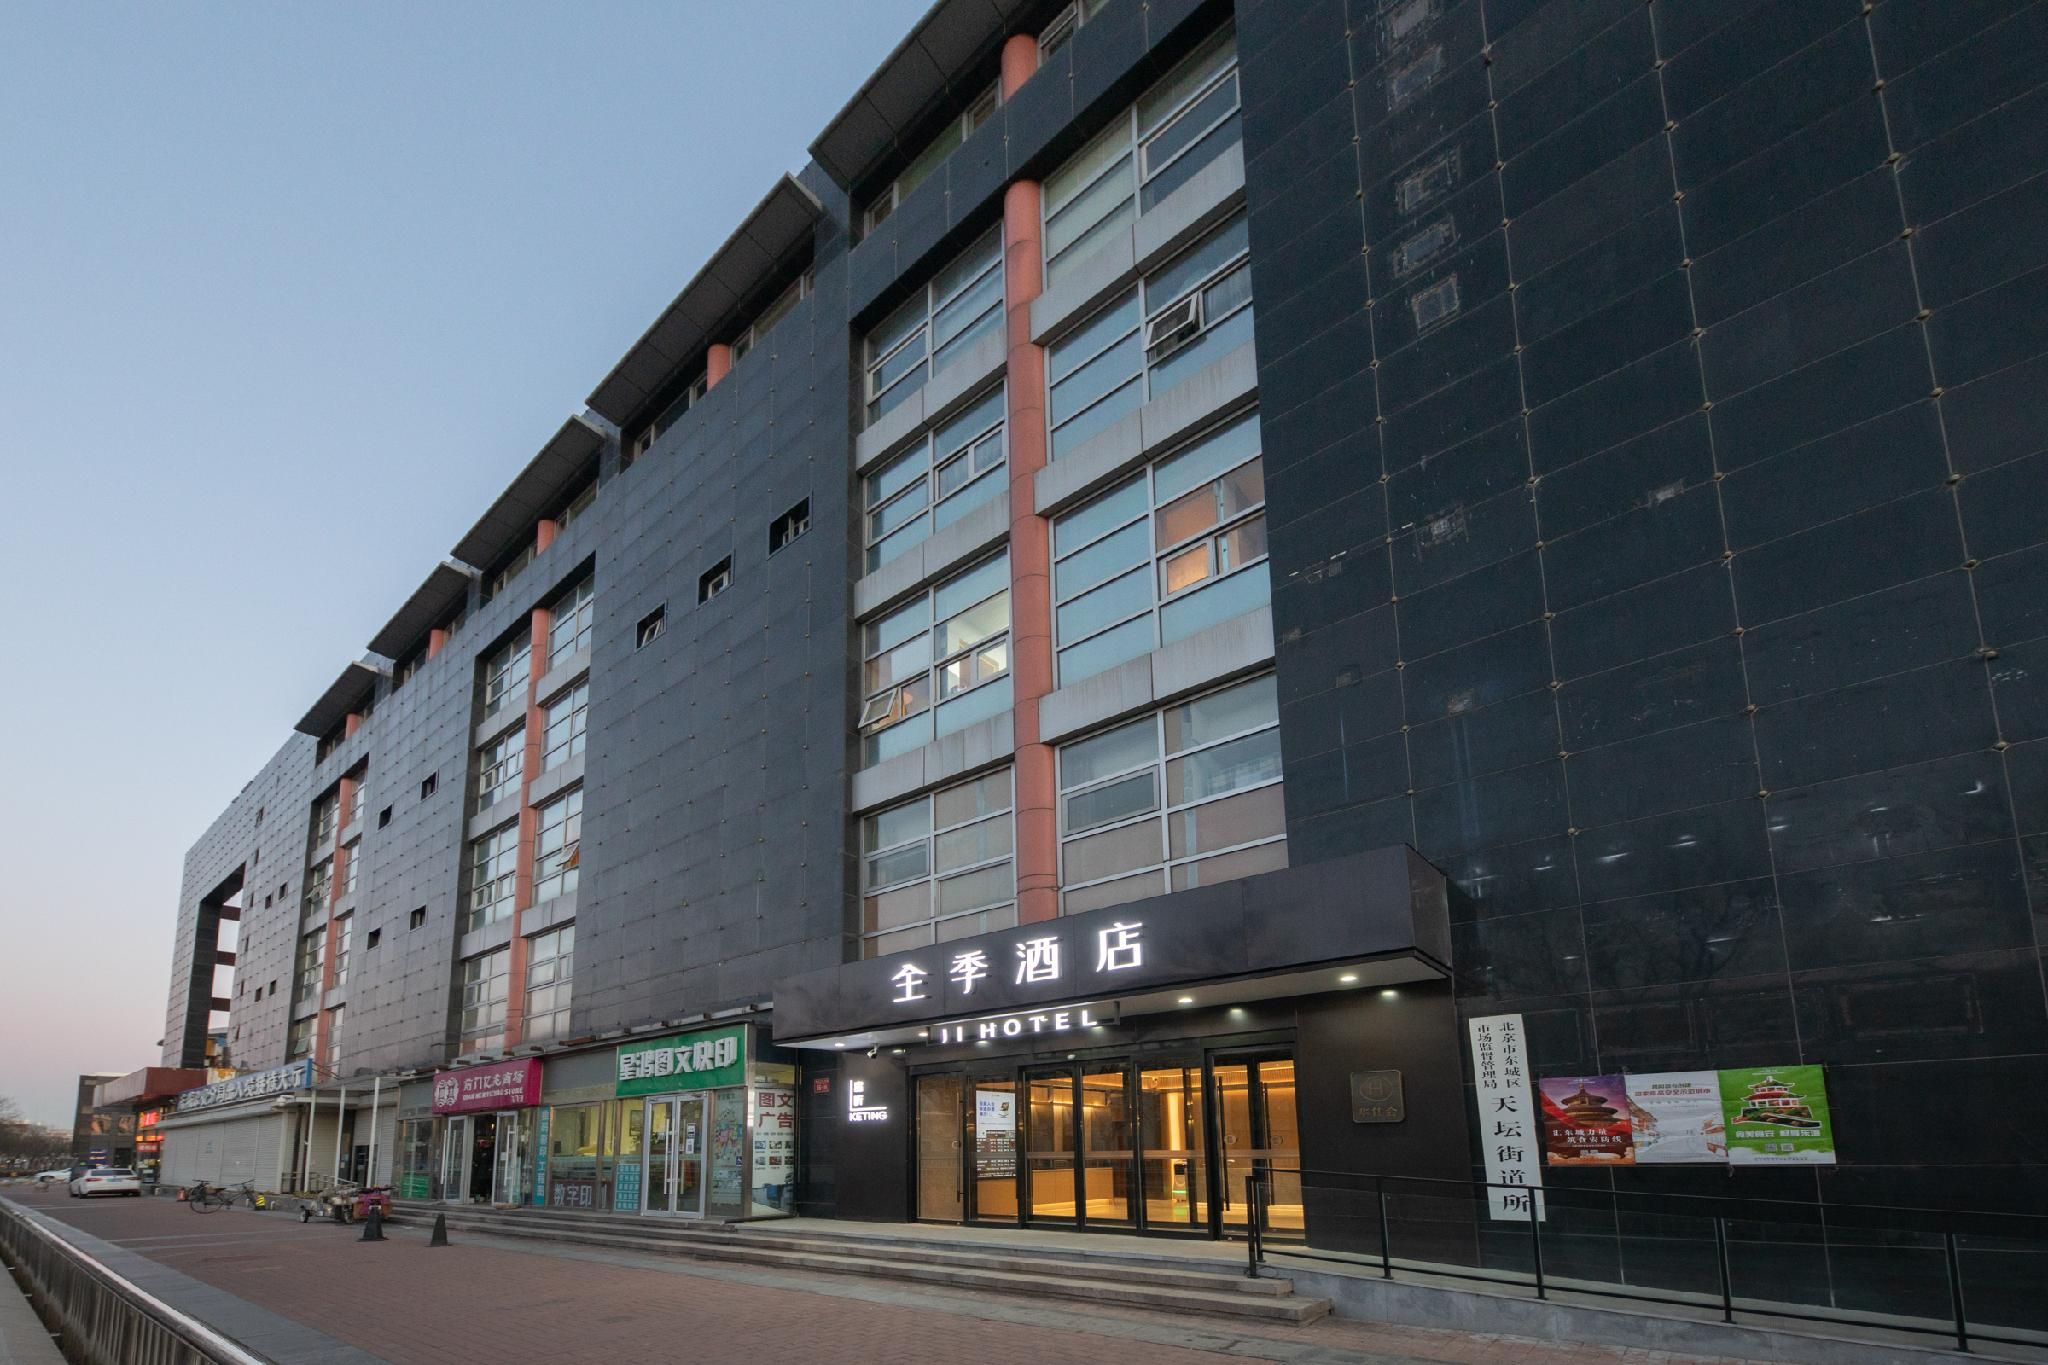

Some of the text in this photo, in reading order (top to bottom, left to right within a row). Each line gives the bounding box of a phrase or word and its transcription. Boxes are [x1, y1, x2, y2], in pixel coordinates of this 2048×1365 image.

[891, 922, 1144, 1003] 全季酒店
[941, 1010, 1097, 1043] JI HOTEL
[1478, 1025, 1497, 1089] 市场监督管理局
[1500, 1022, 1521, 1088] 北京市东城区
[758, 1112, 793, 1129] 广告
[759, 1093, 793, 1108] 图文
[849, 1111, 888, 1122] KETING
[1491, 1096, 1532, 1213] 天坛街道所
